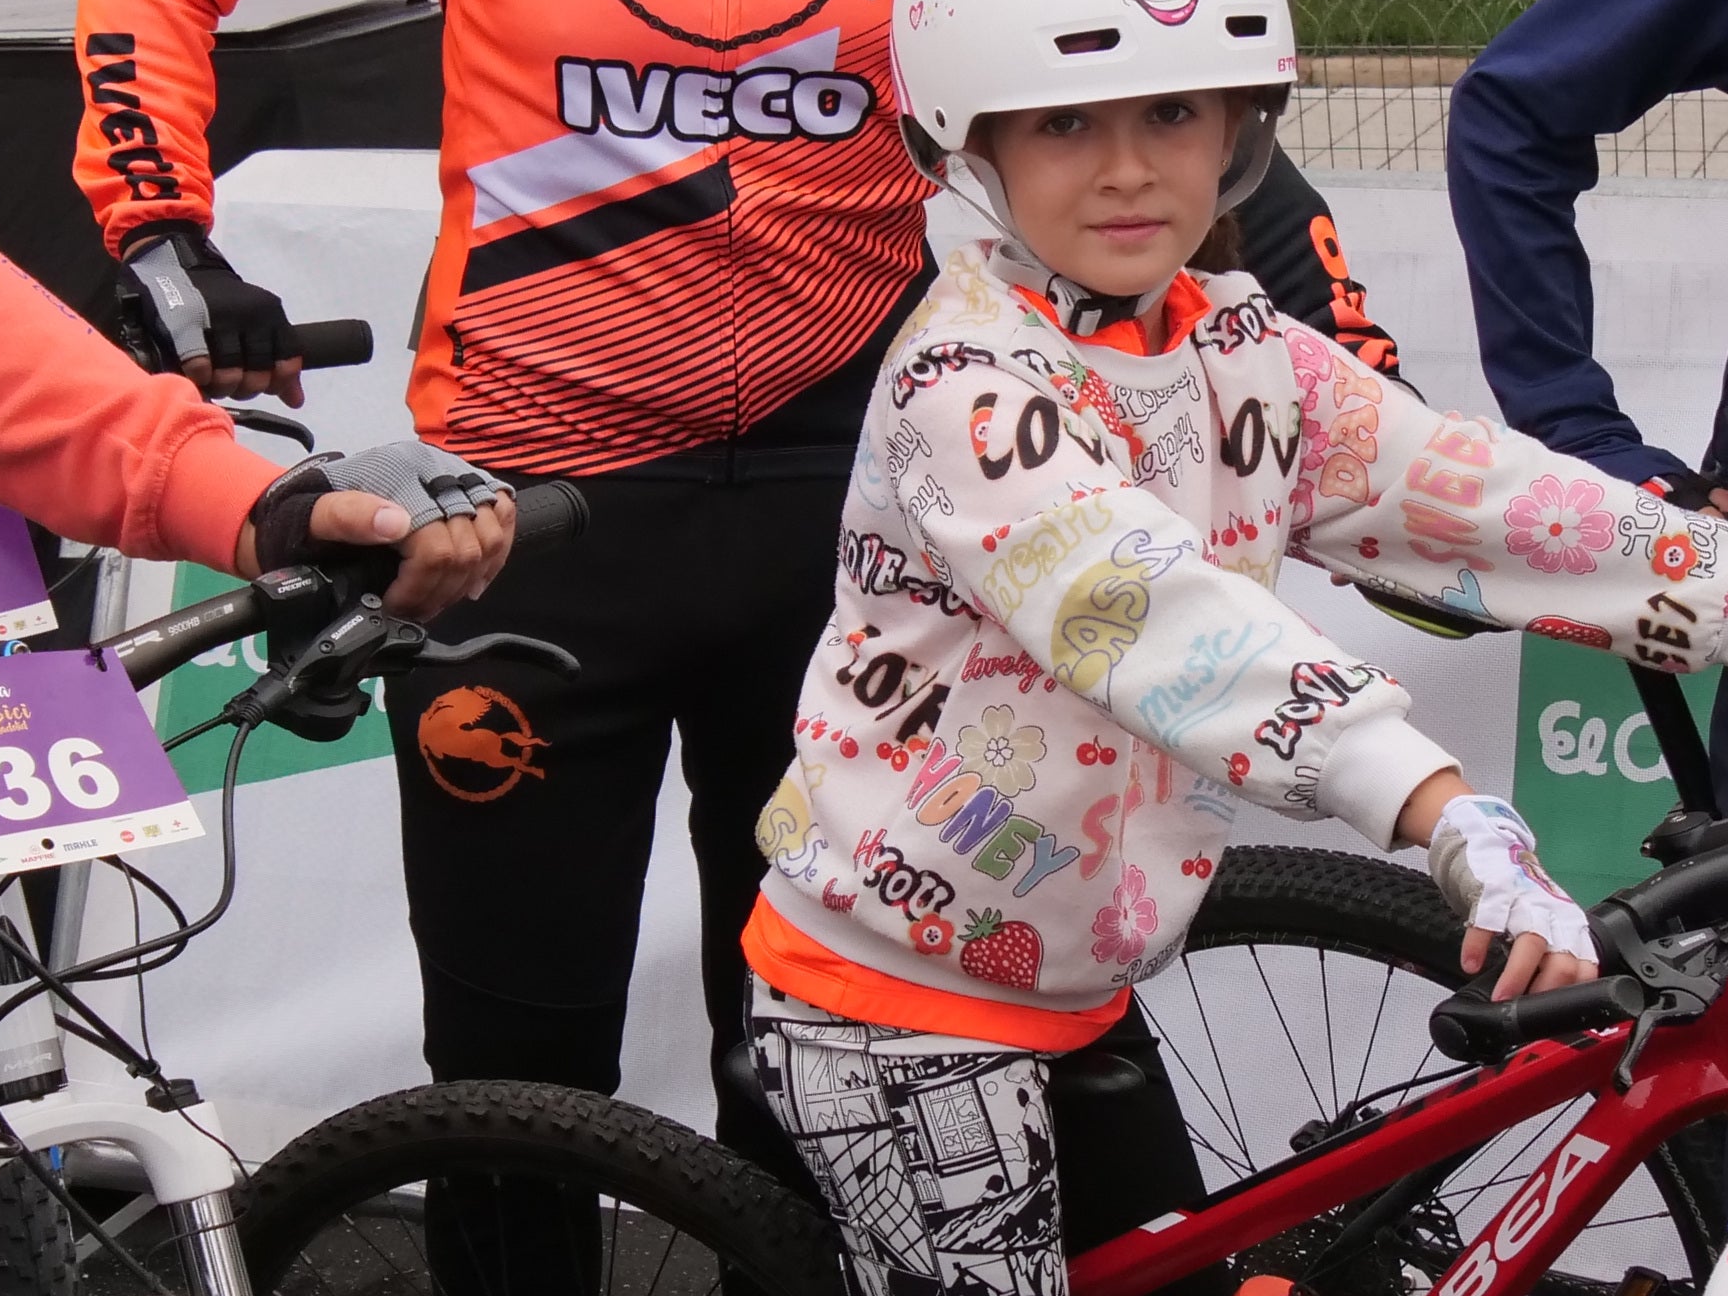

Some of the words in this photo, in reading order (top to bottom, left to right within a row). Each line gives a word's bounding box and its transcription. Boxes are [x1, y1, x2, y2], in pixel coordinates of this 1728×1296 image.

[556, 56, 875, 141] IVECO
[1320, 360, 1384, 504] DAY
[904, 737, 1080, 898] HONEY
